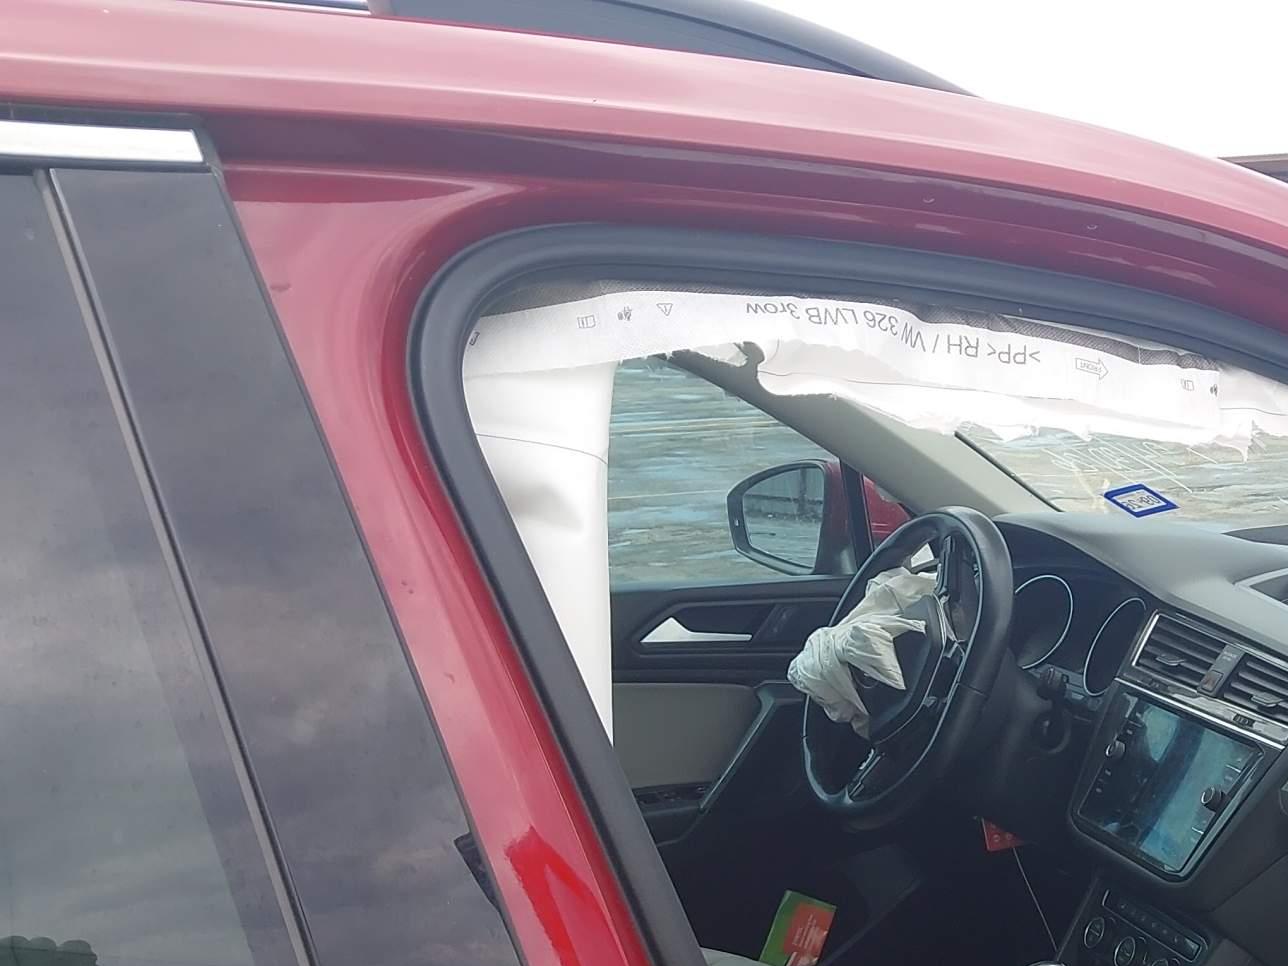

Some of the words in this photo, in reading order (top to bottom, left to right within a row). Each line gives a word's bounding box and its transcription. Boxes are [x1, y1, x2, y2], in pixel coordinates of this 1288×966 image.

[746, 302, 800, 319] 3row
[807, 306, 858, 326] LWB
[864, 310, 898, 336] 326
[900, 322, 926, 352] VW
[933, 334, 940, 353] /
[947, 334, 980, 358] RH
